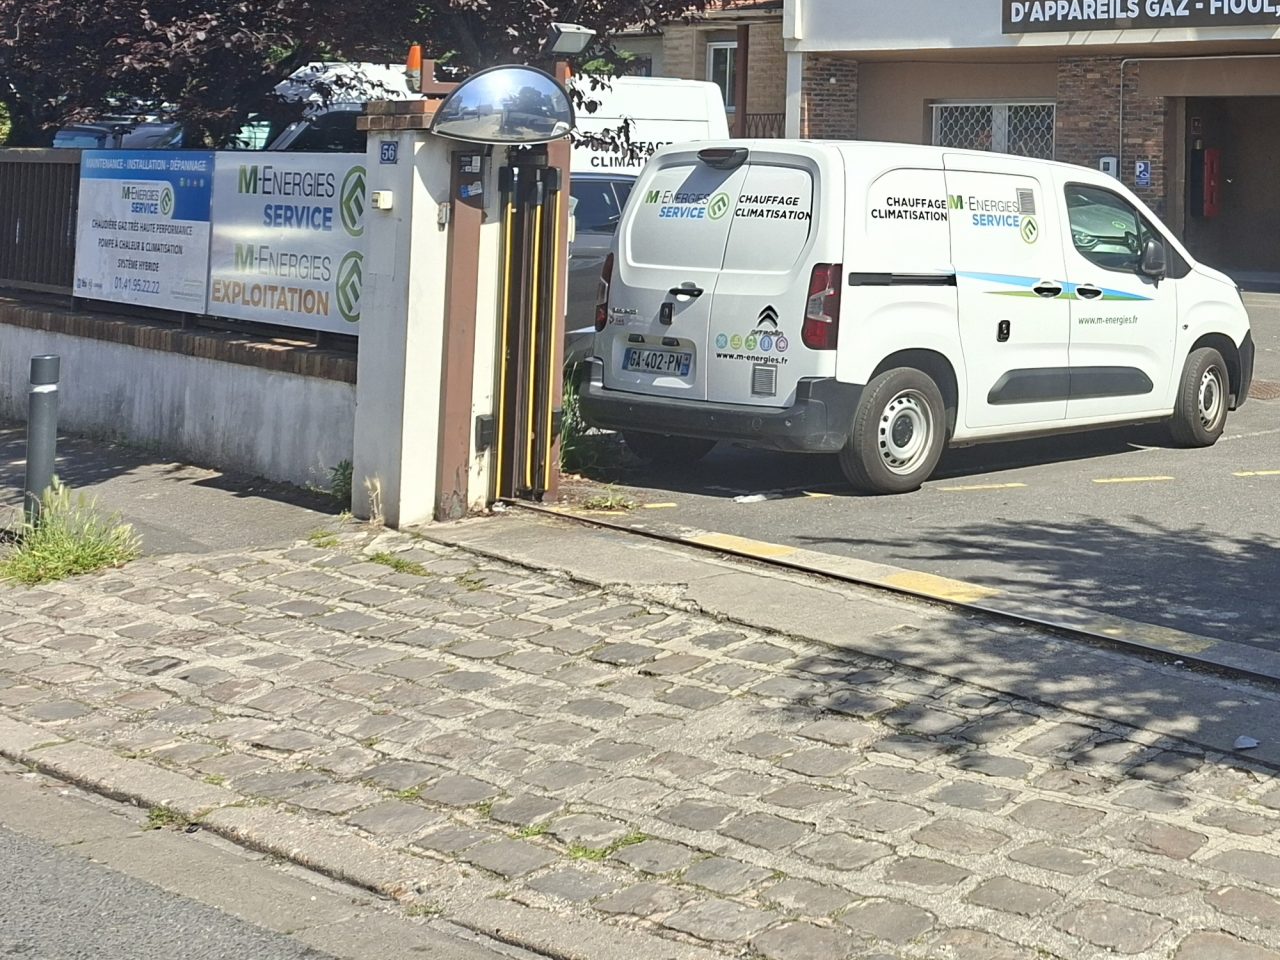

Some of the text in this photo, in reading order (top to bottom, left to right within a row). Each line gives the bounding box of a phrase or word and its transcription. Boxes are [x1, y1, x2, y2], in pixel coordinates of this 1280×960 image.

[381, 145, 395, 160] 56
[86, 158, 123, 169] MAINTENANCE
[127, 159, 165, 170] INSTALLATION
[739, 194, 800, 206] CHAUFFAGE
[886, 196, 947, 209] CHAUFFAGE
[131, 202, 158, 214] SERVICE
[659, 206, 706, 219] SERVICE
[735, 208, 811, 220] CLIMATISATION
[263, 204, 333, 231] SERVICE
[871, 209, 948, 221] CLIMATISATION
[972, 214, 1020, 228] SERVICE
[118, 220, 128, 230] GAZ
[140, 222, 155, 233] HAUTE
[156, 223, 192, 236] PERFORMANCE
[98, 238, 114, 248] POMPE
[119, 240, 140, 251] CHALEUR
[145, 242, 183, 255] CLIMATISATION
[138, 261, 159, 272] HYBRIDE
[211, 279, 329, 316] EXPLOITATION
[1078, 315, 1138, 326] www.m-energies.fr
[630, 351, 682, 371] GA-402-PN
[716, 352, 788, 365] www.m-energies.fr
